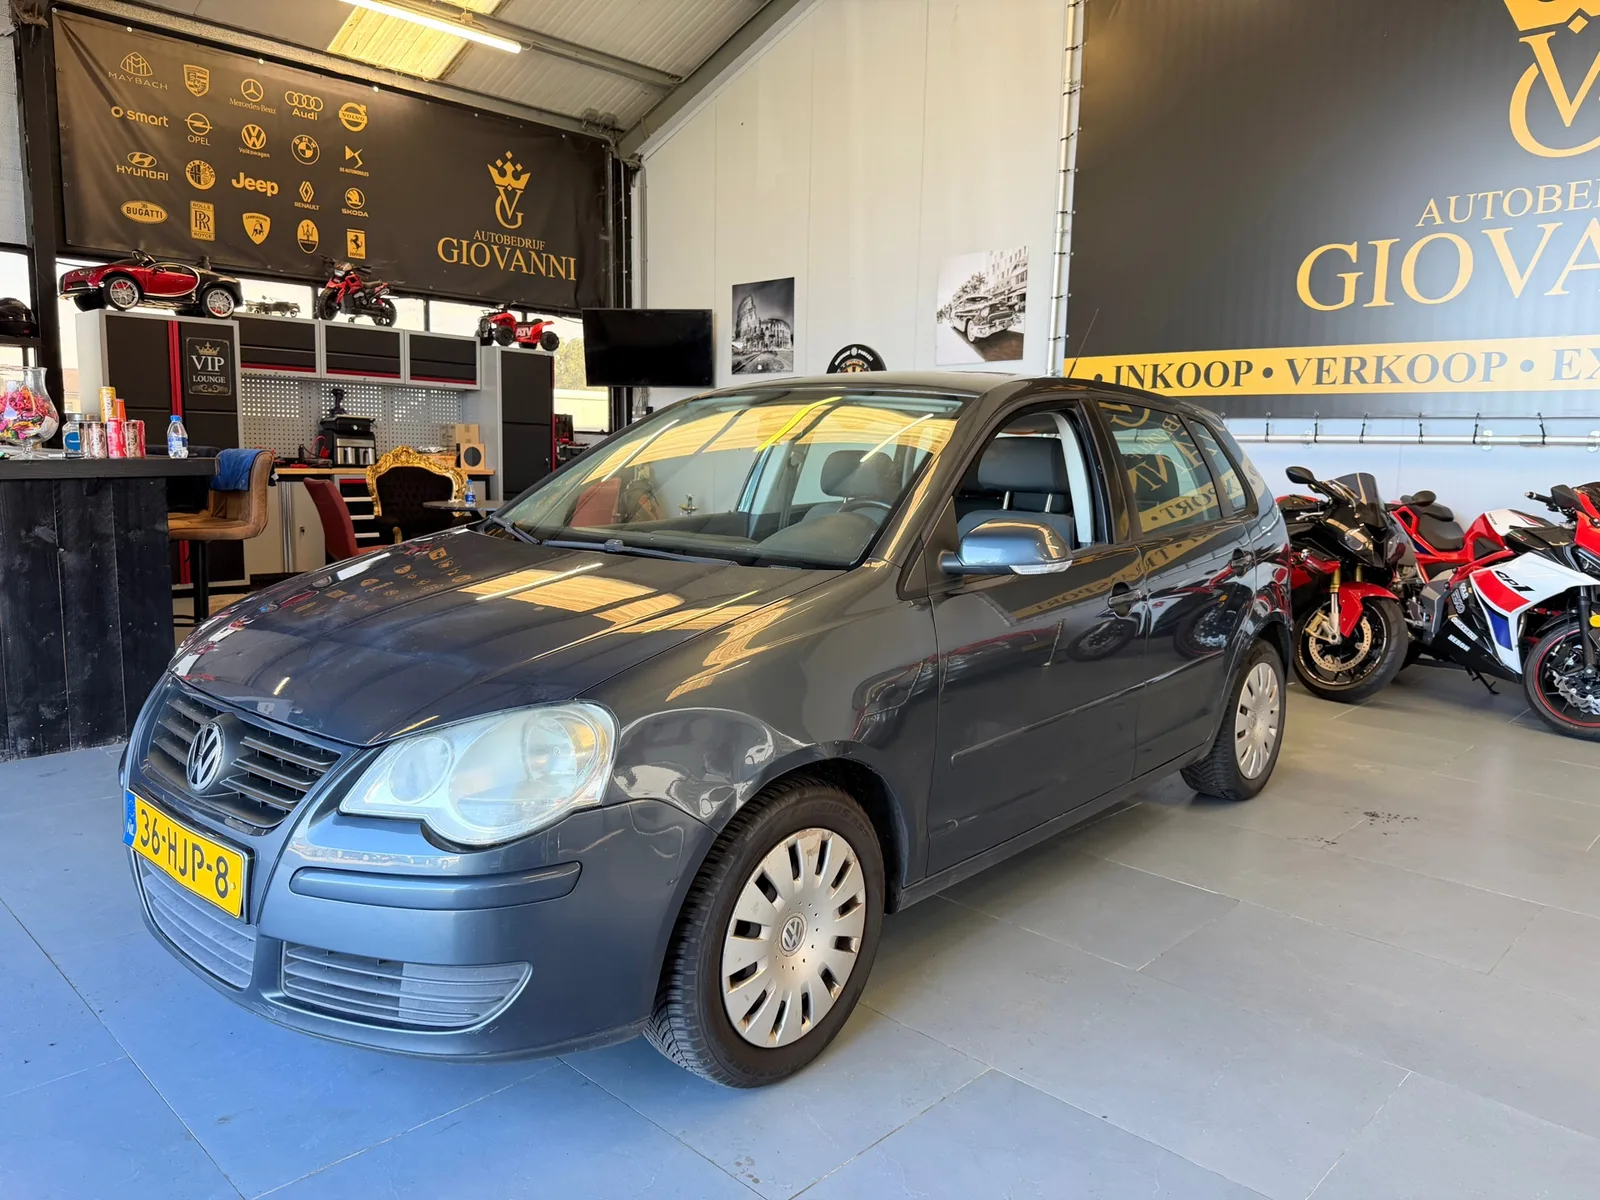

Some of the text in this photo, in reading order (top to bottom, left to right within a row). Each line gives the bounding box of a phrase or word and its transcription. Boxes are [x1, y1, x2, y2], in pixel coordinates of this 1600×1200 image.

[108, 71, 168, 91] MAYBACH
[229, 97, 277, 115] Mercedes-Benz
[126, 109, 169, 128] smart
[292, 108, 318, 121] Audi
[342, 112, 365, 122] VOLVO
[187, 134, 211, 146] OPEL
[294, 136, 317, 149] BMW
[238, 147, 271, 158] Volkswagen
[116, 164, 169, 181] HYUNDAI
[231, 172, 279, 197] Jeep
[126, 206, 163, 219] BUGATTI
[192, 202, 211, 210] ROLLS
[294, 201, 320, 211] RENAULT
[473, 230, 546, 251] AUTOBEDRIJF
[437, 237, 577, 281] GIOVANNI
[515, 326, 533, 337] ATV
[190, 355, 225, 372] VIP
[1113, 360, 1254, 390] INKOOP
[1285, 351, 1508, 387] VERKOOP
[192, 375, 226, 384] LOUNGE
[140, 808, 229, 899] 36-HJP-8
